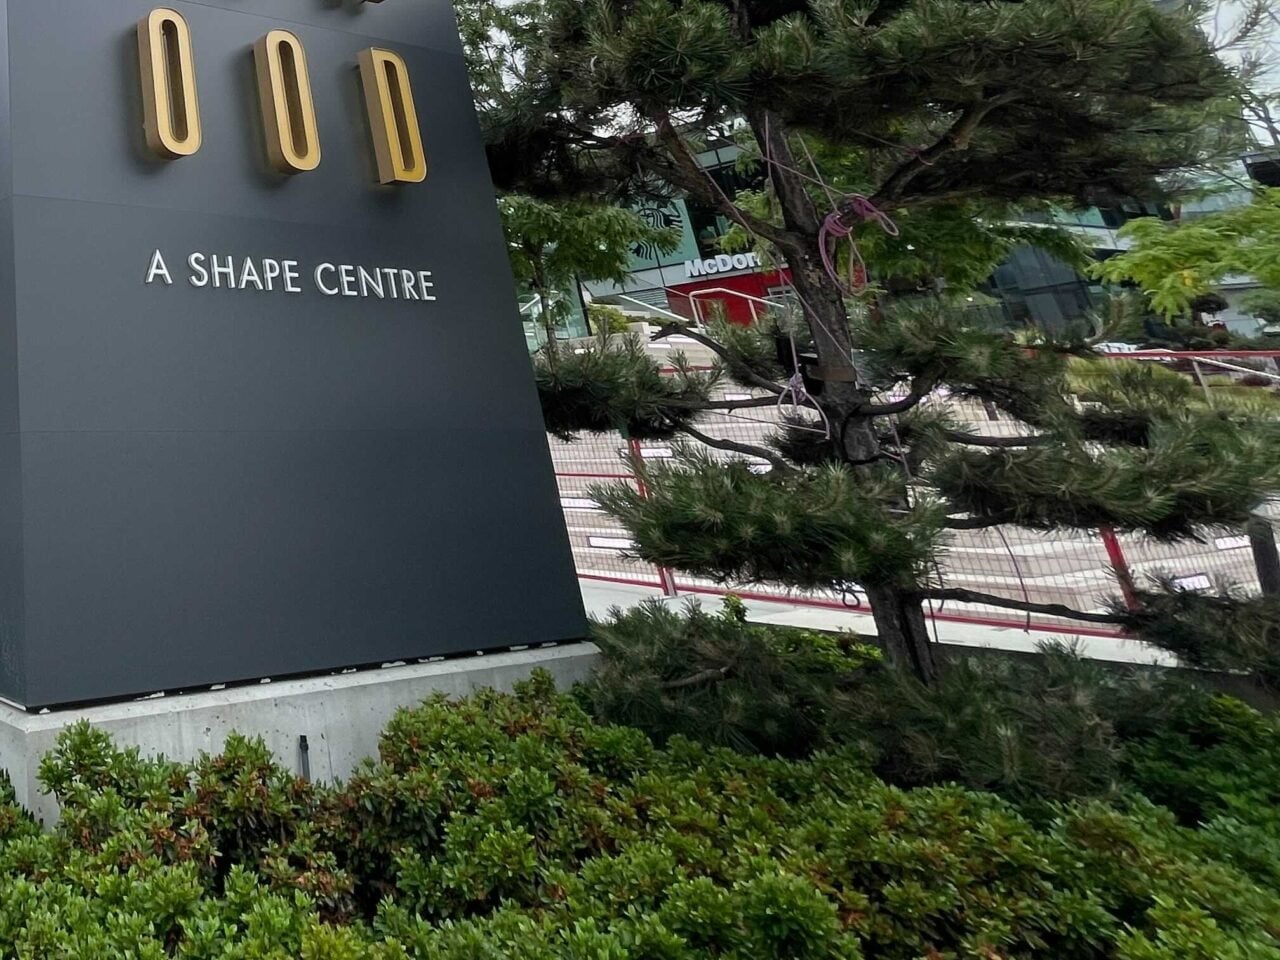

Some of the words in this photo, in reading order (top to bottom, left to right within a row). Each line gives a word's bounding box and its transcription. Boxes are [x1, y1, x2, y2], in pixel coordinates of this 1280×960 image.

[145, 248, 173, 284] A
[187, 252, 302, 293] SHAPE
[313, 262, 437, 301] CENTRE
[684, 251, 762, 277] McDon
